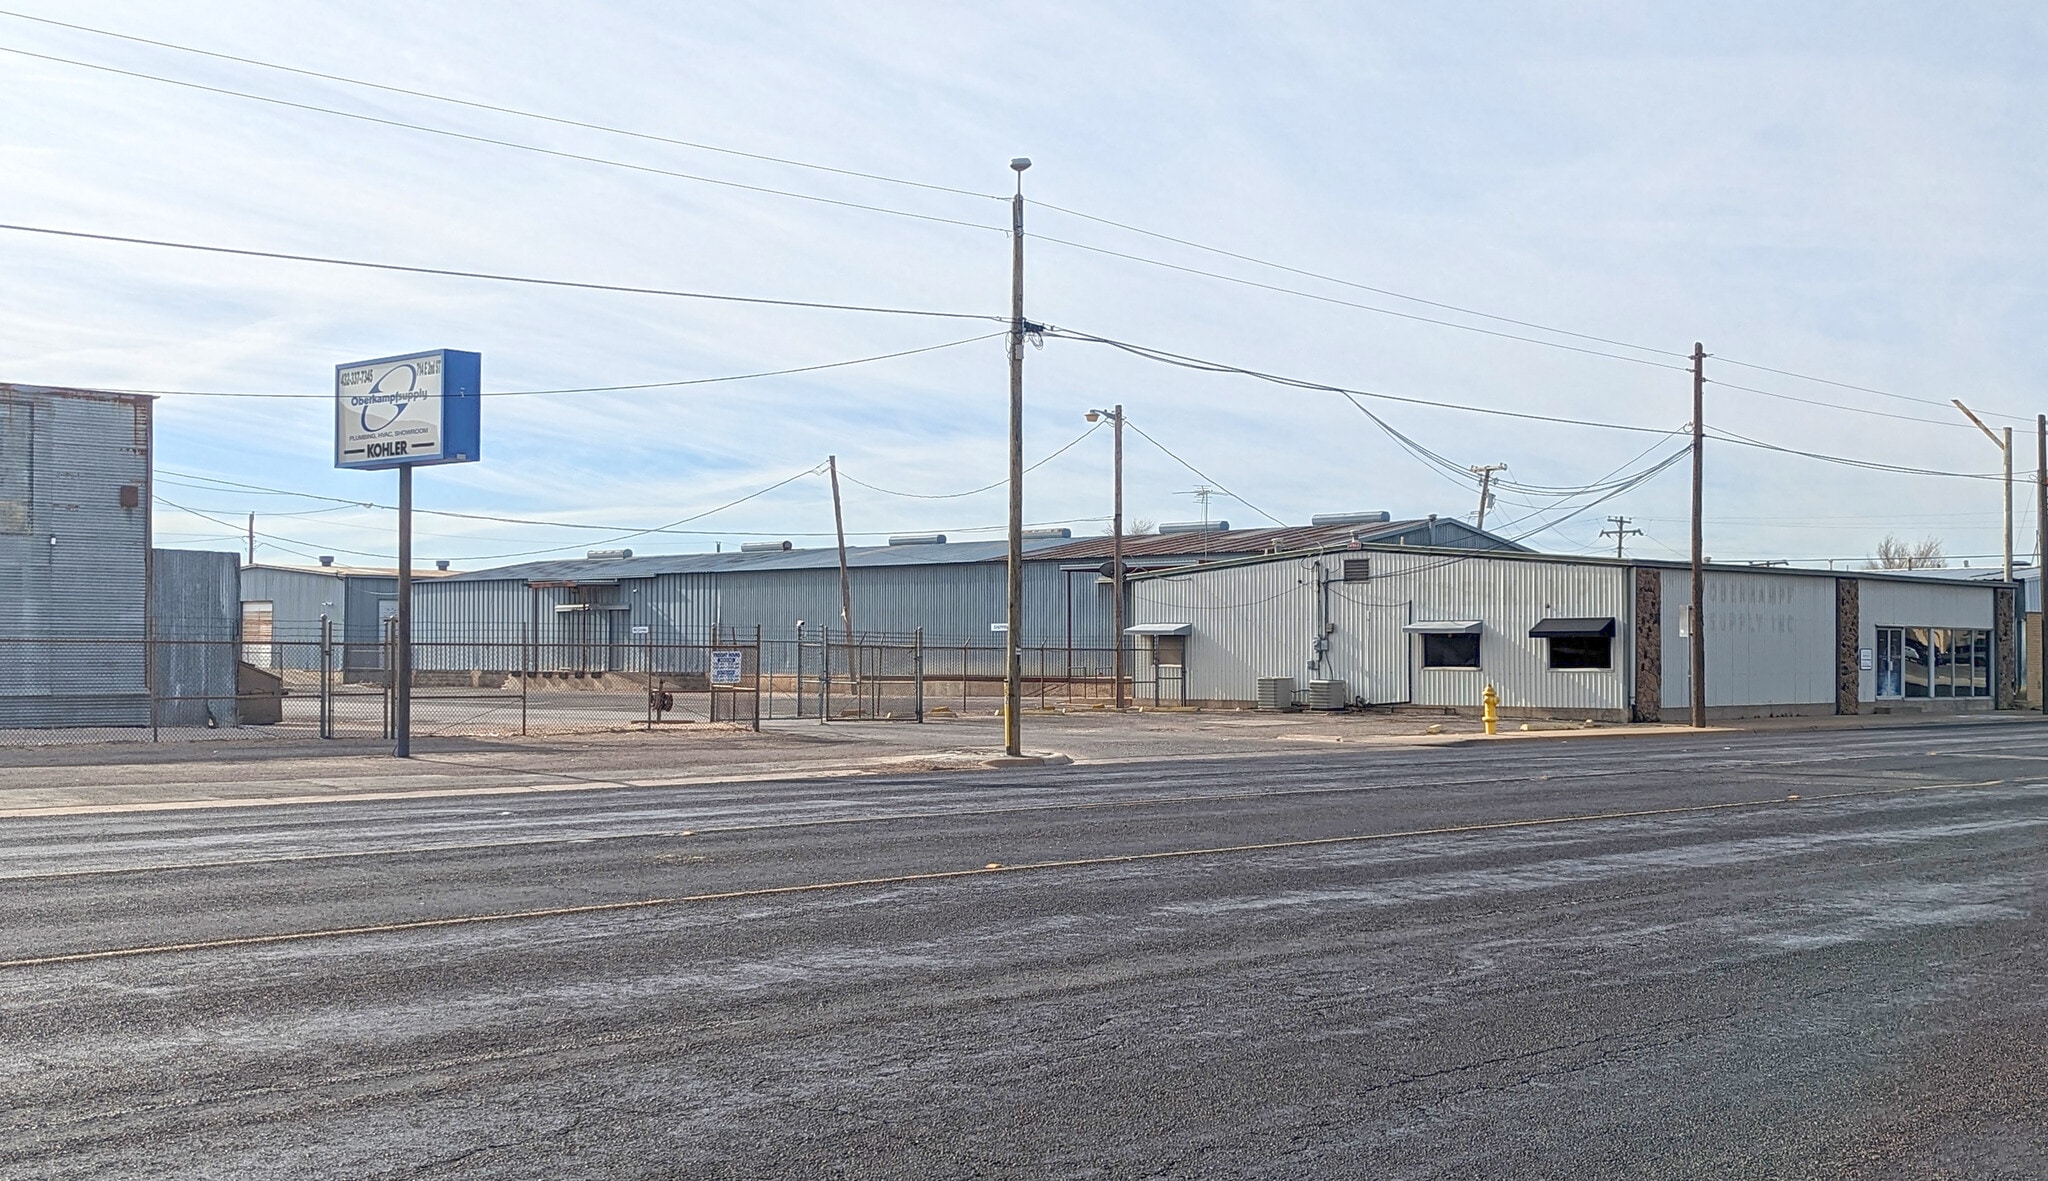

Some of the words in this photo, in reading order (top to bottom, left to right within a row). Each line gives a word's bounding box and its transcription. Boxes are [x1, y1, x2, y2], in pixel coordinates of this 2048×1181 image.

[395, 427, 429, 436] SHOWROOM
[367, 440, 408, 458] KOHLER
[1709, 612, 1763, 633] SUPPLY
